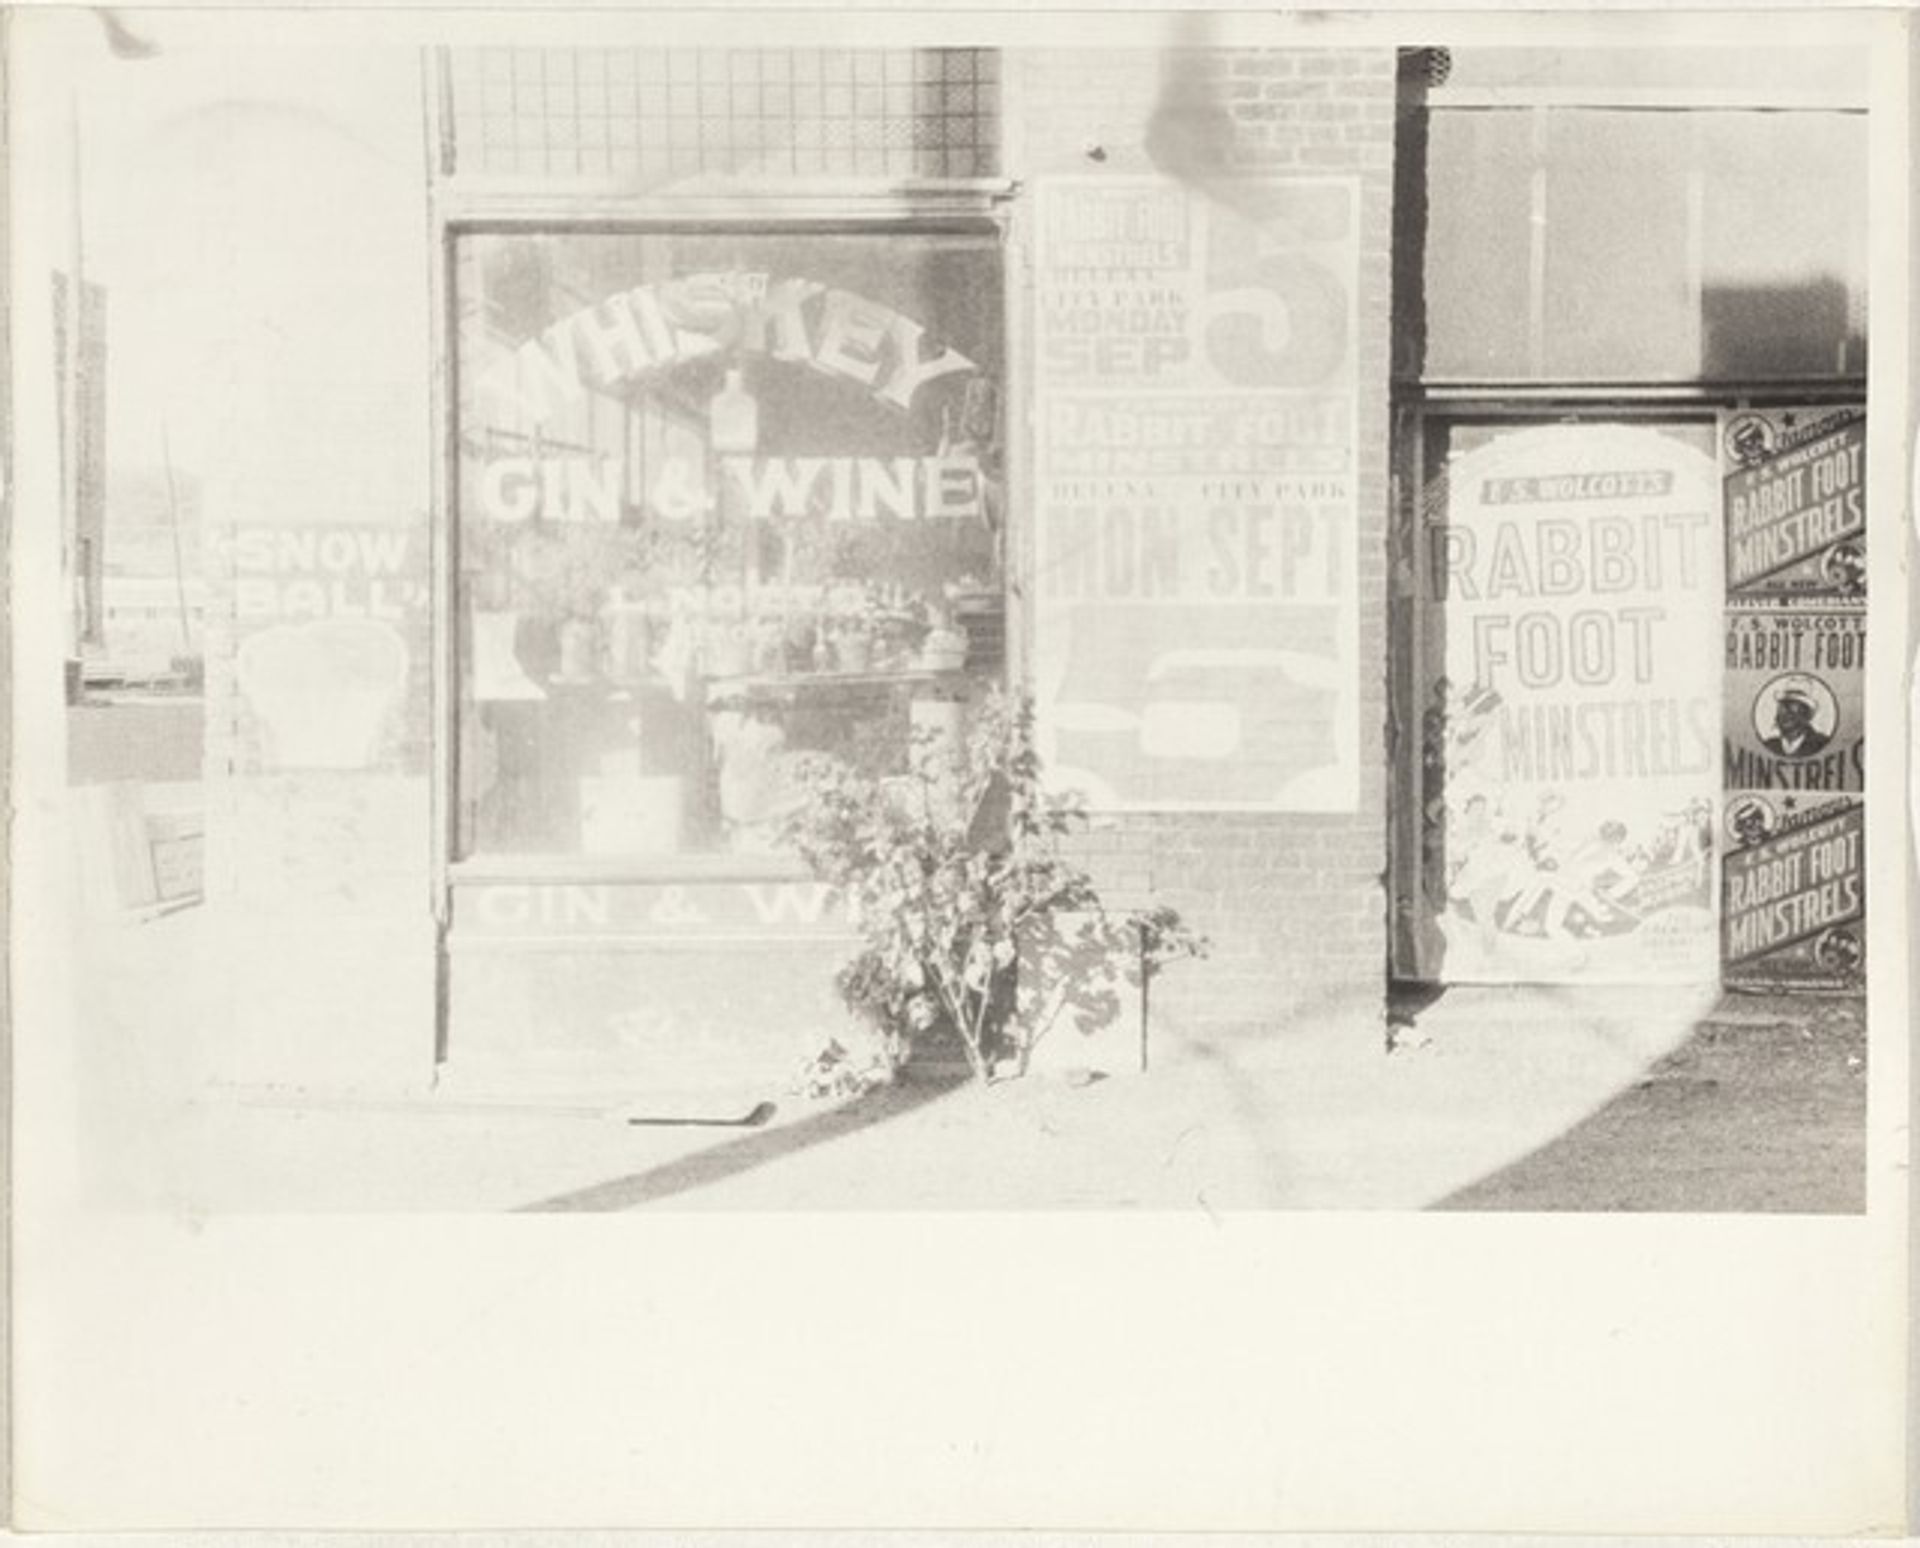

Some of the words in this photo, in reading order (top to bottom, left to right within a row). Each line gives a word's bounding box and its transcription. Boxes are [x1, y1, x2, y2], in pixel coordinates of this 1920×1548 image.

[472, 268, 977, 425] WHISKEY
[1045, 337, 1191, 376] SEP
[1046, 309, 1190, 334] MONDAY
[482, 458, 622, 522] GIN
[652, 458, 716, 520] &
[719, 456, 979, 519] WINE
[1200, 481, 1262, 500] CITY
[1274, 481, 1346, 500] PARK
[1733, 467, 1805, 536] RABBIT
[1811, 440, 1863, 504] FOOT
[1046, 503, 1179, 598] MON
[1206, 503, 1351, 598] SEPT
[1430, 511, 1711, 601] RABBIT
[1734, 486, 1863, 582] MINSTRELS
[1472, 605, 1668, 691] FOOT
[1725, 631, 1805, 671] RABBIT
[1814, 631, 1866, 671] FOOT
[1502, 698, 1713, 783] MINSTRELS
[478, 885, 608, 924] GIN
[648, 885, 712, 924] &
[1729, 852, 1804, 915] RABBIT
[1809, 830, 1860, 884] FOOT
[1728, 873, 1860, 960] MINSTRELS
